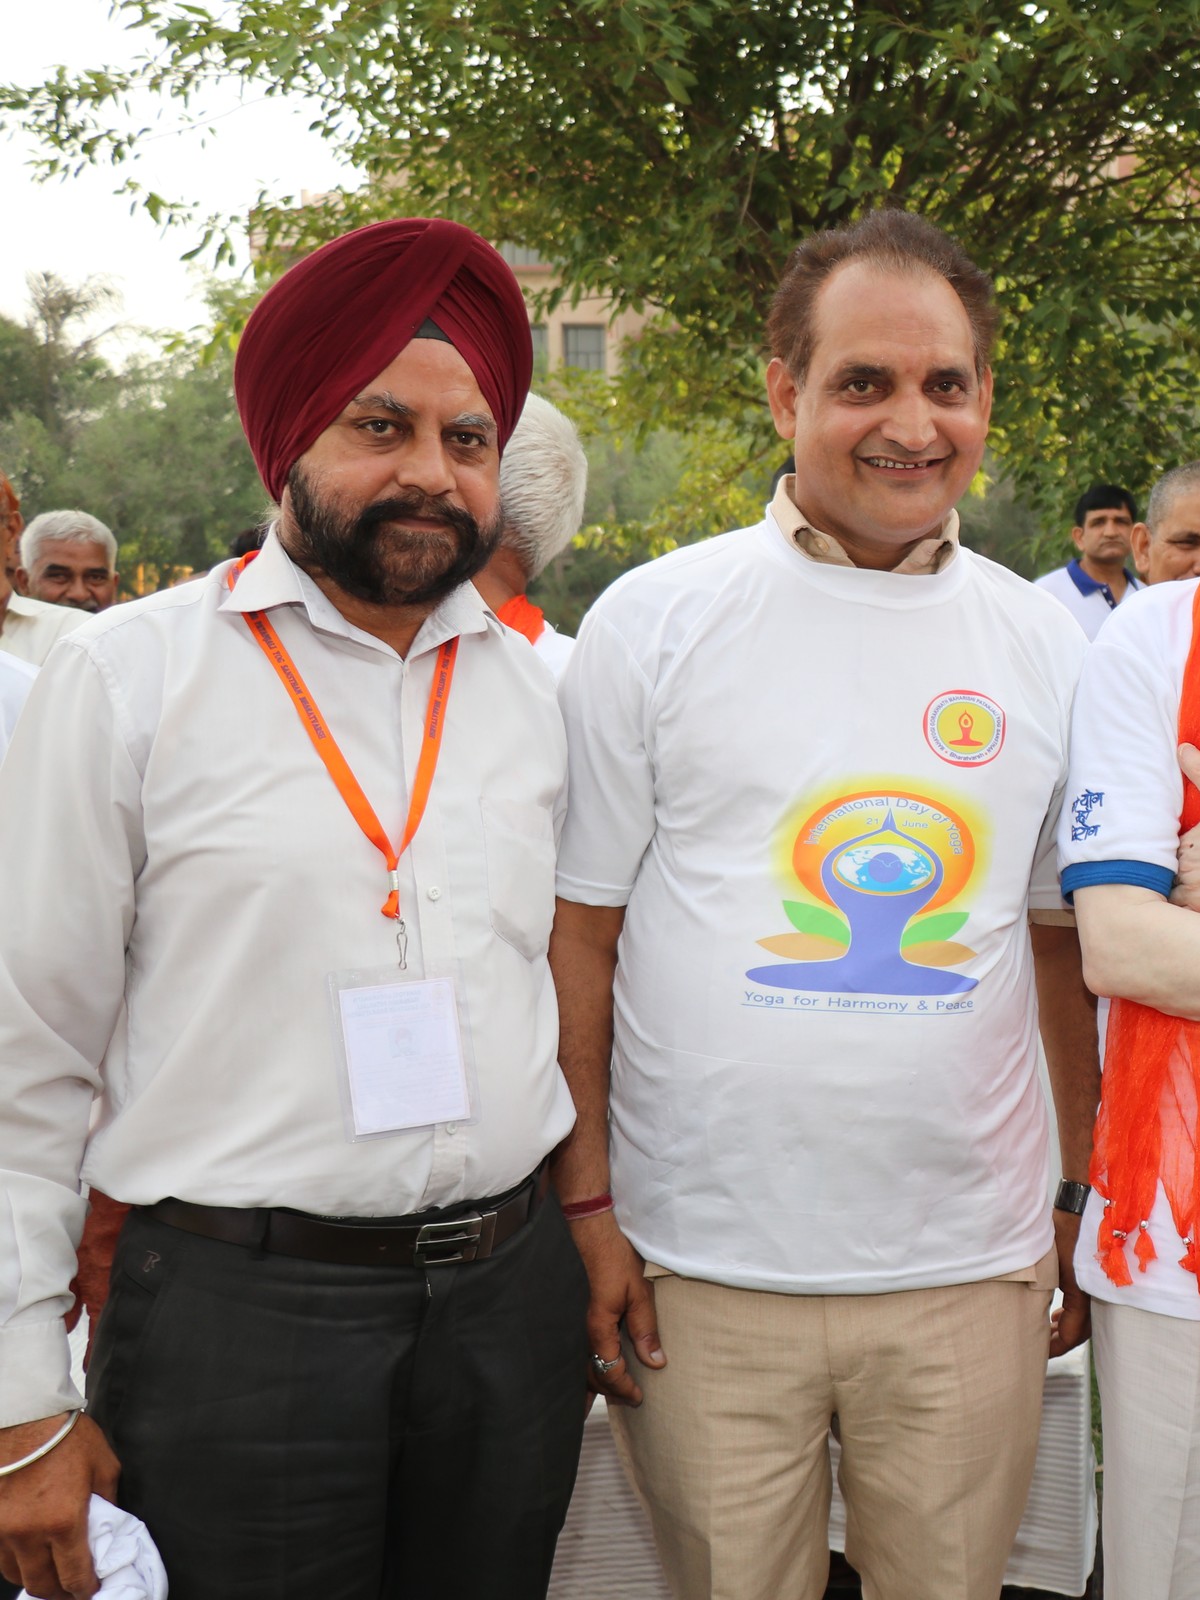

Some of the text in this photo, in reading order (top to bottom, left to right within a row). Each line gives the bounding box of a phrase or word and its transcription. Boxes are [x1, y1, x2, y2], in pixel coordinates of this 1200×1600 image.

[272, 650, 285, 664] YOG
[804, 797, 964, 855] International Day of Yoga
[866, 817, 929, 829] 21 June
[744, 991, 974, 1012] Yoga for Harmony & Peace
